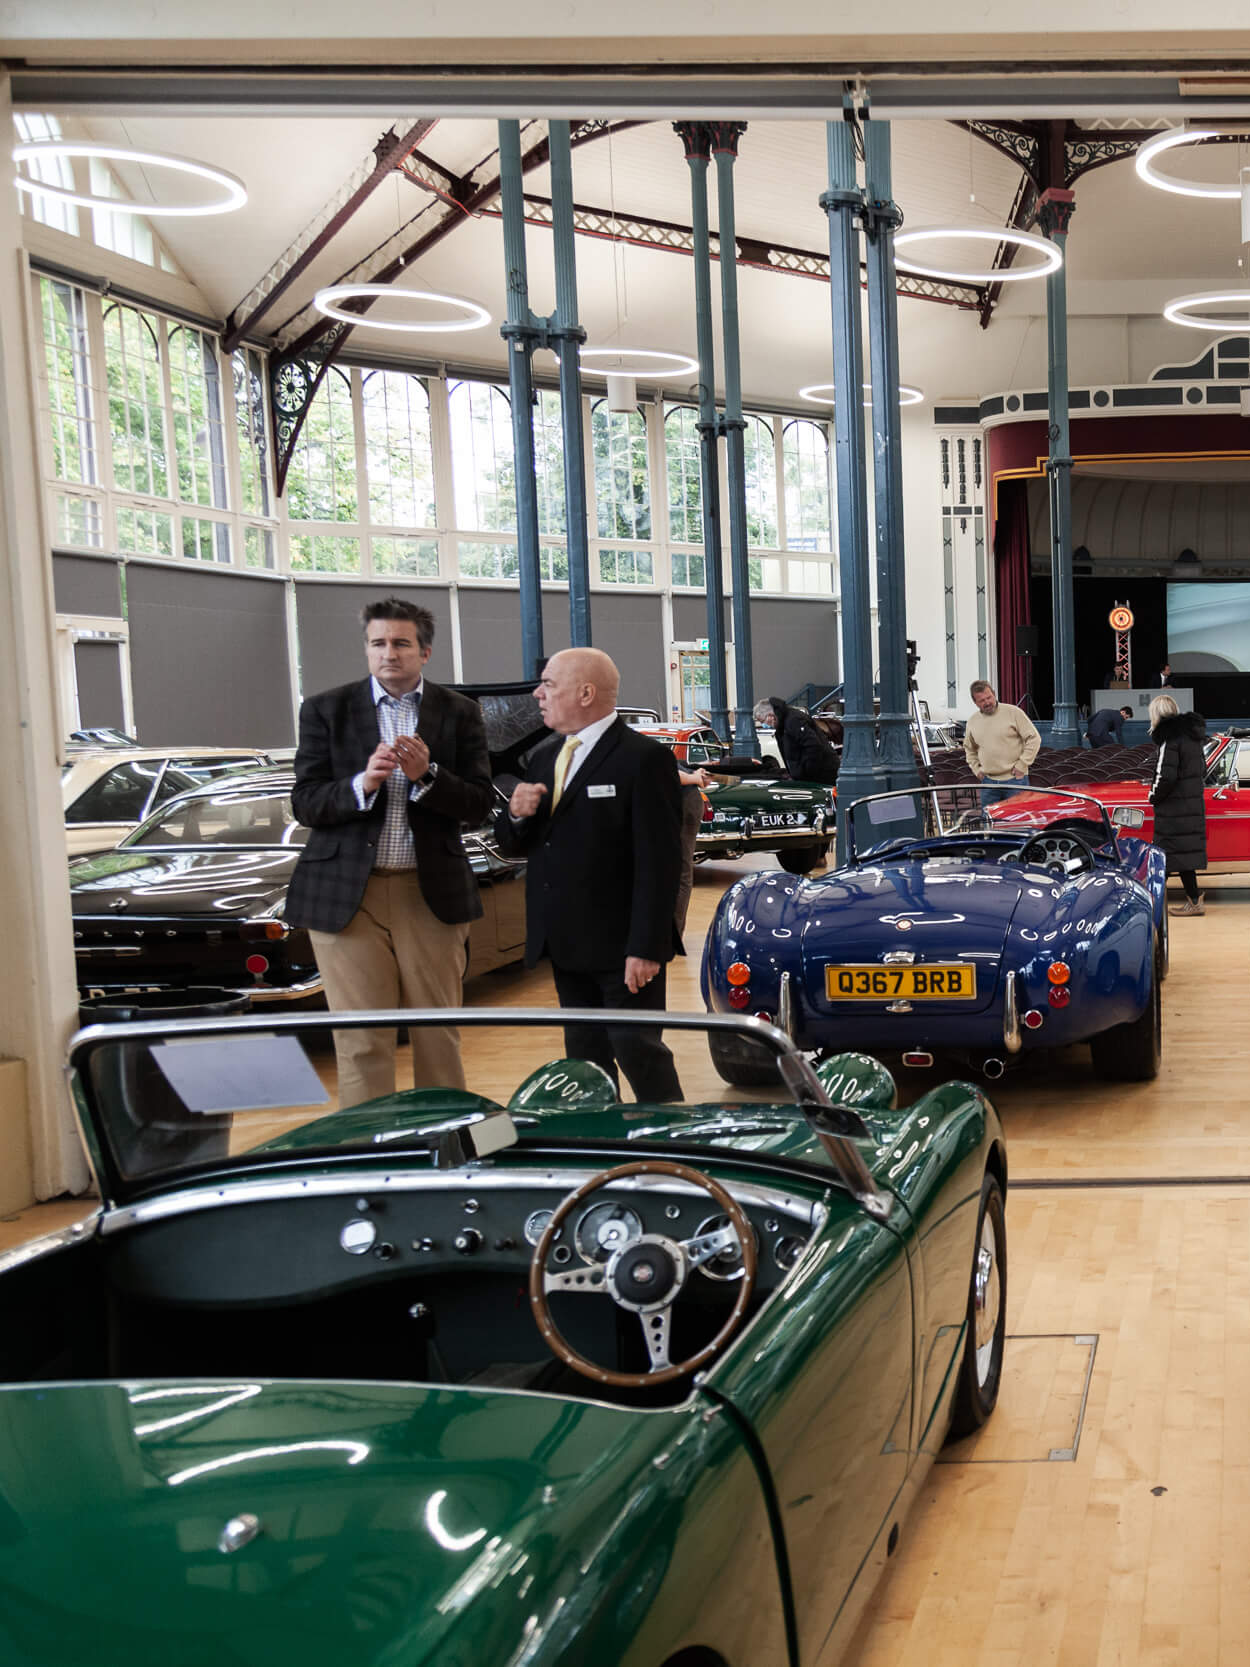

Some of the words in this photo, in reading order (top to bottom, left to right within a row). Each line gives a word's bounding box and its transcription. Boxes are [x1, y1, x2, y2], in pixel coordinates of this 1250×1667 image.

[761, 814, 785, 827] EUK
[74, 929, 177, 938] OLVO
[838, 971, 904, 994] Q367
[912, 971, 962, 994] BRB
